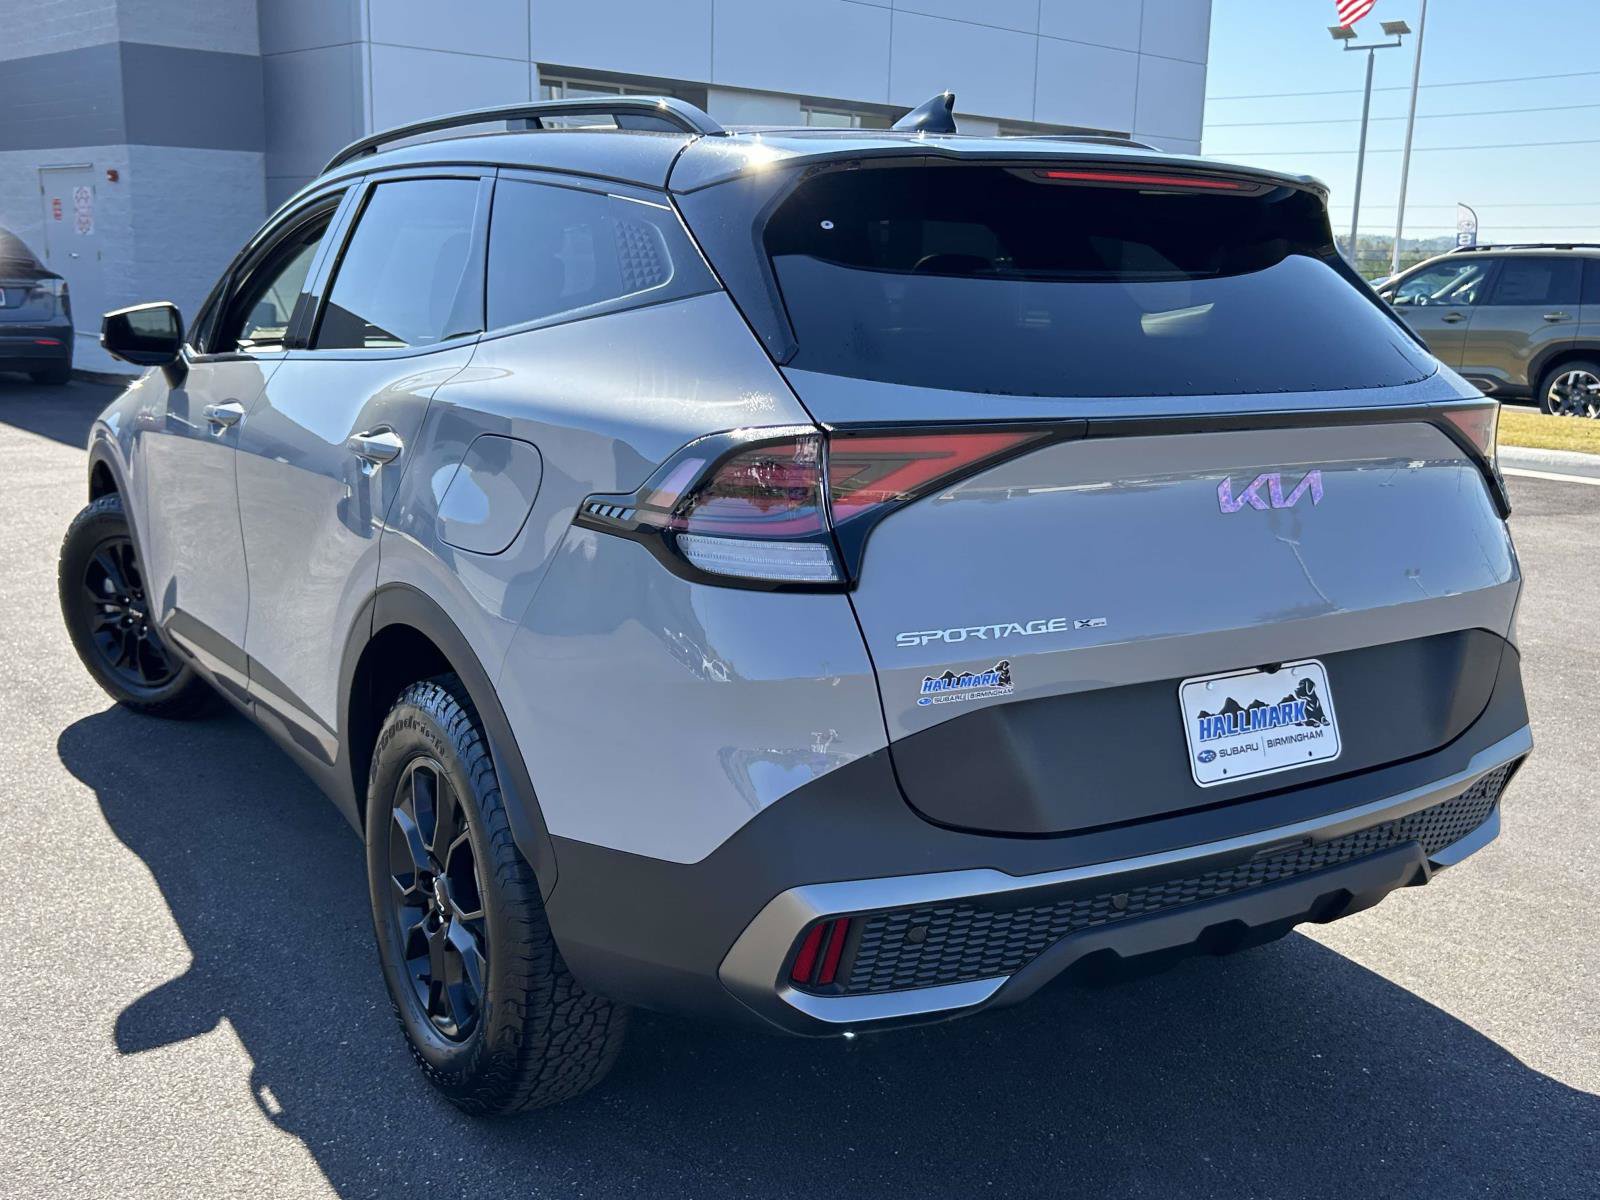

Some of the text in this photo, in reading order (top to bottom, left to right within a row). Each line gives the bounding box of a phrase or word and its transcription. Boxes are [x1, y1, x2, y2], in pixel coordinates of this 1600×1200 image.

[1217, 469, 1324, 514] KIA
[896, 617, 1068, 647] SPORTAGE
[922, 672, 1000, 693] HALLMARK
[933, 687, 1014, 704] SUBARU BIRMINGHAM
[1199, 700, 1308, 741] HALLMARK
[1218, 729, 1324, 758] SUBARU BIRMINGHAM
